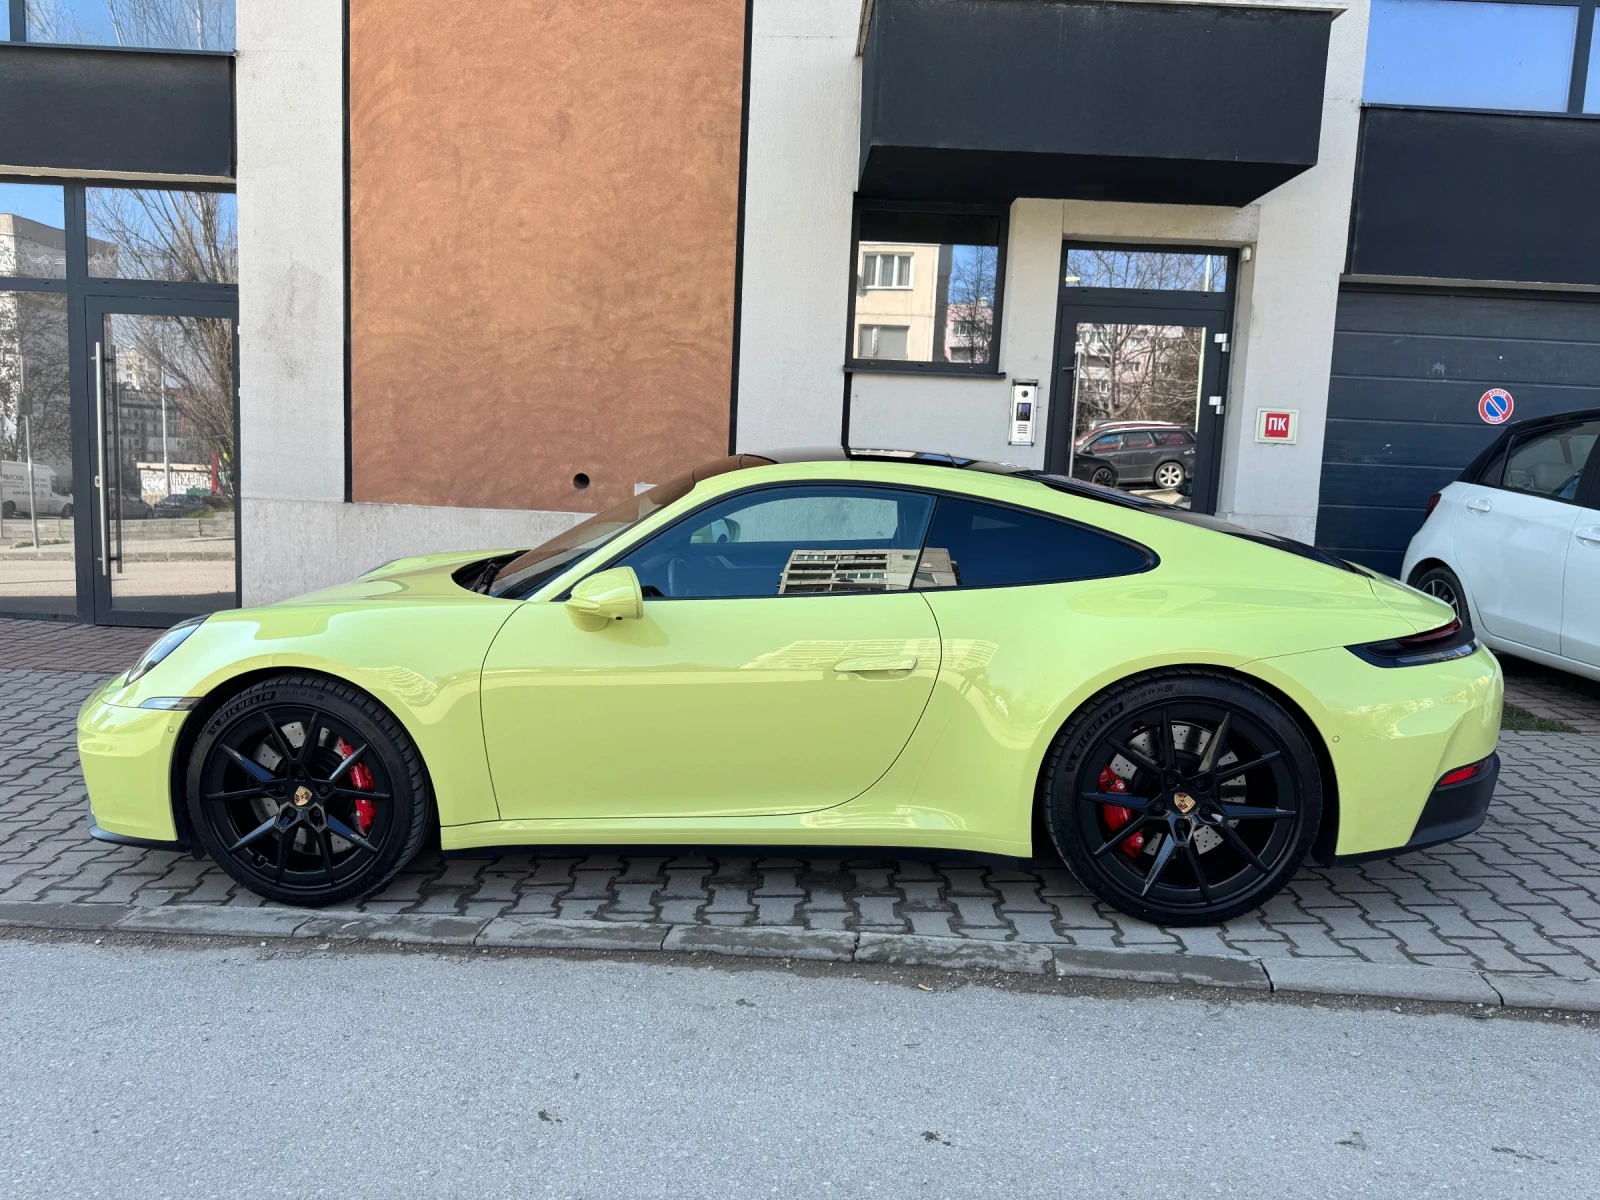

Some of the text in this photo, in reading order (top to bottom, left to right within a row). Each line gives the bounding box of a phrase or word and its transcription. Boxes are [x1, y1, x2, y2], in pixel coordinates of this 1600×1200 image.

[1268, 417, 1287, 431] ПК
[219, 692, 273, 724] MICHELIN
[1074, 703, 1120, 758] MICHELIN
